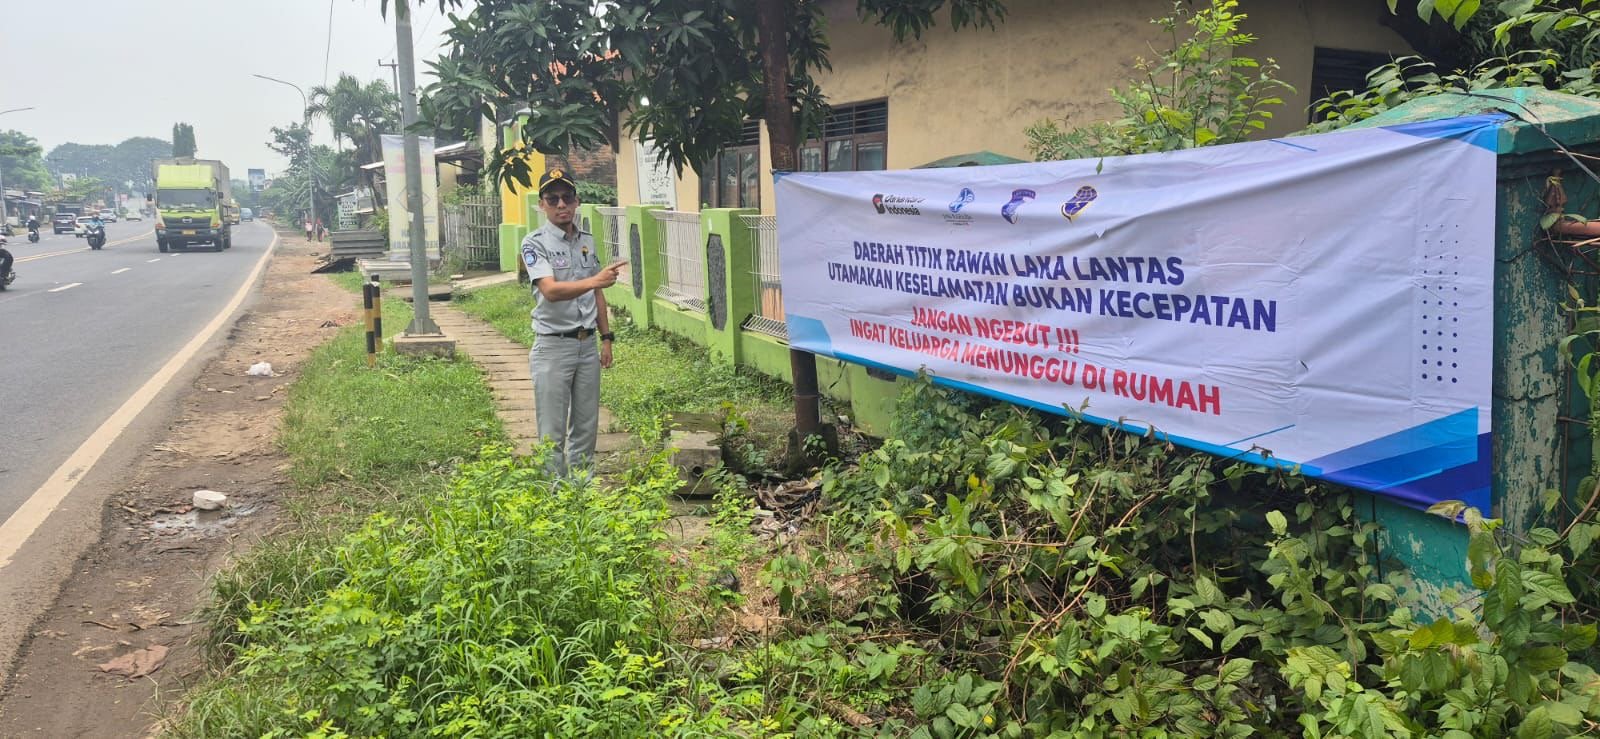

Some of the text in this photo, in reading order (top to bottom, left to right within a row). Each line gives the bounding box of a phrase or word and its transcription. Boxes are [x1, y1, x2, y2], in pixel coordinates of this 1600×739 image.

[886, 204, 920, 216] Indonesia
[853, 240, 1185, 286] DAERAH TITIK RAWAN LAKA LANTAS
[828, 261, 1277, 332] UTAMAKAN KESELAMATAN BUKAN KECEPATAN
[910, 306, 1079, 354] JANGAN NGEBUT !!!
[850, 318, 1221, 416] INGAT KELUARGA MENUNGGU DI RUMAH
